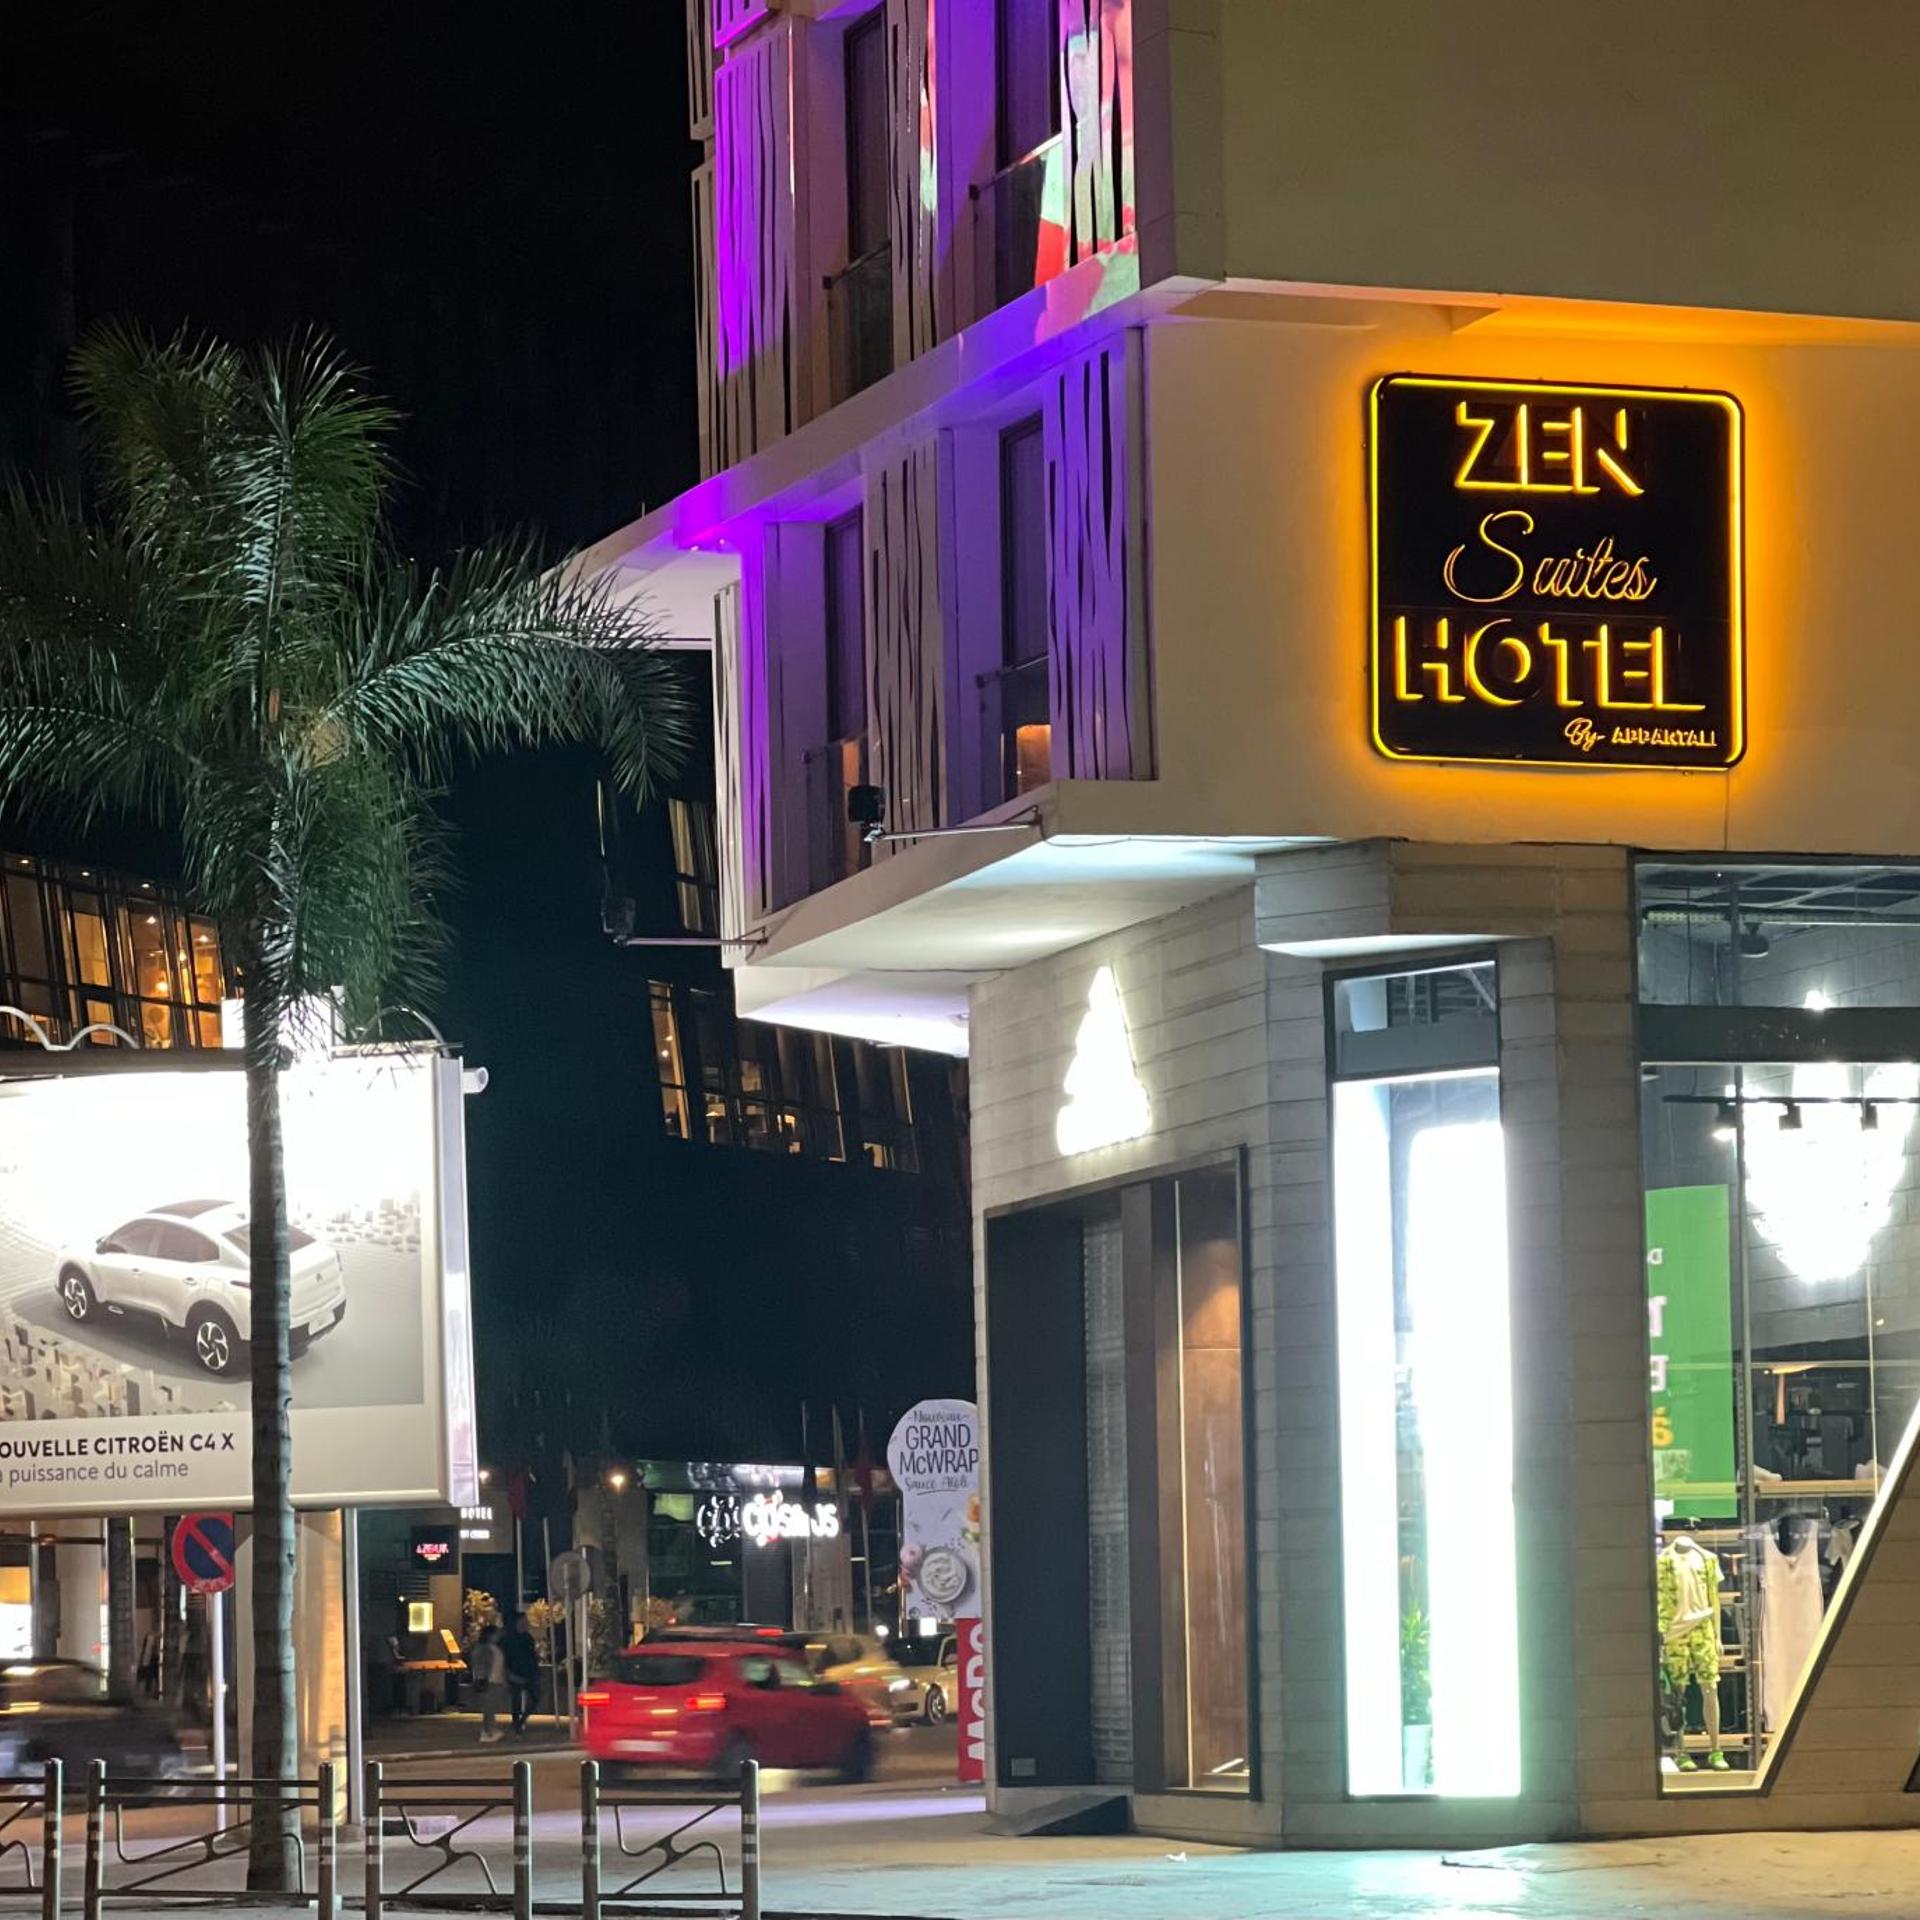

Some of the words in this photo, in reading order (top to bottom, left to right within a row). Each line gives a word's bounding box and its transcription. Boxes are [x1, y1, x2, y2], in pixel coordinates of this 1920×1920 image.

[1455, 401, 1645, 495] ZEN
[1443, 510, 1658, 602] Suites
[1395, 616, 1707, 711] HOTEL
[94, 1430, 183, 1454] CITROËN
[190, 1433, 216, 1451] C4
[222, 1432, 234, 1450] X
[905, 1423, 971, 1450] GRAND
[9, 1463, 98, 1488] puissance
[104, 1461, 127, 1479] du
[133, 1460, 188, 1477] calme
[900, 1448, 979, 1475] McWRAP
